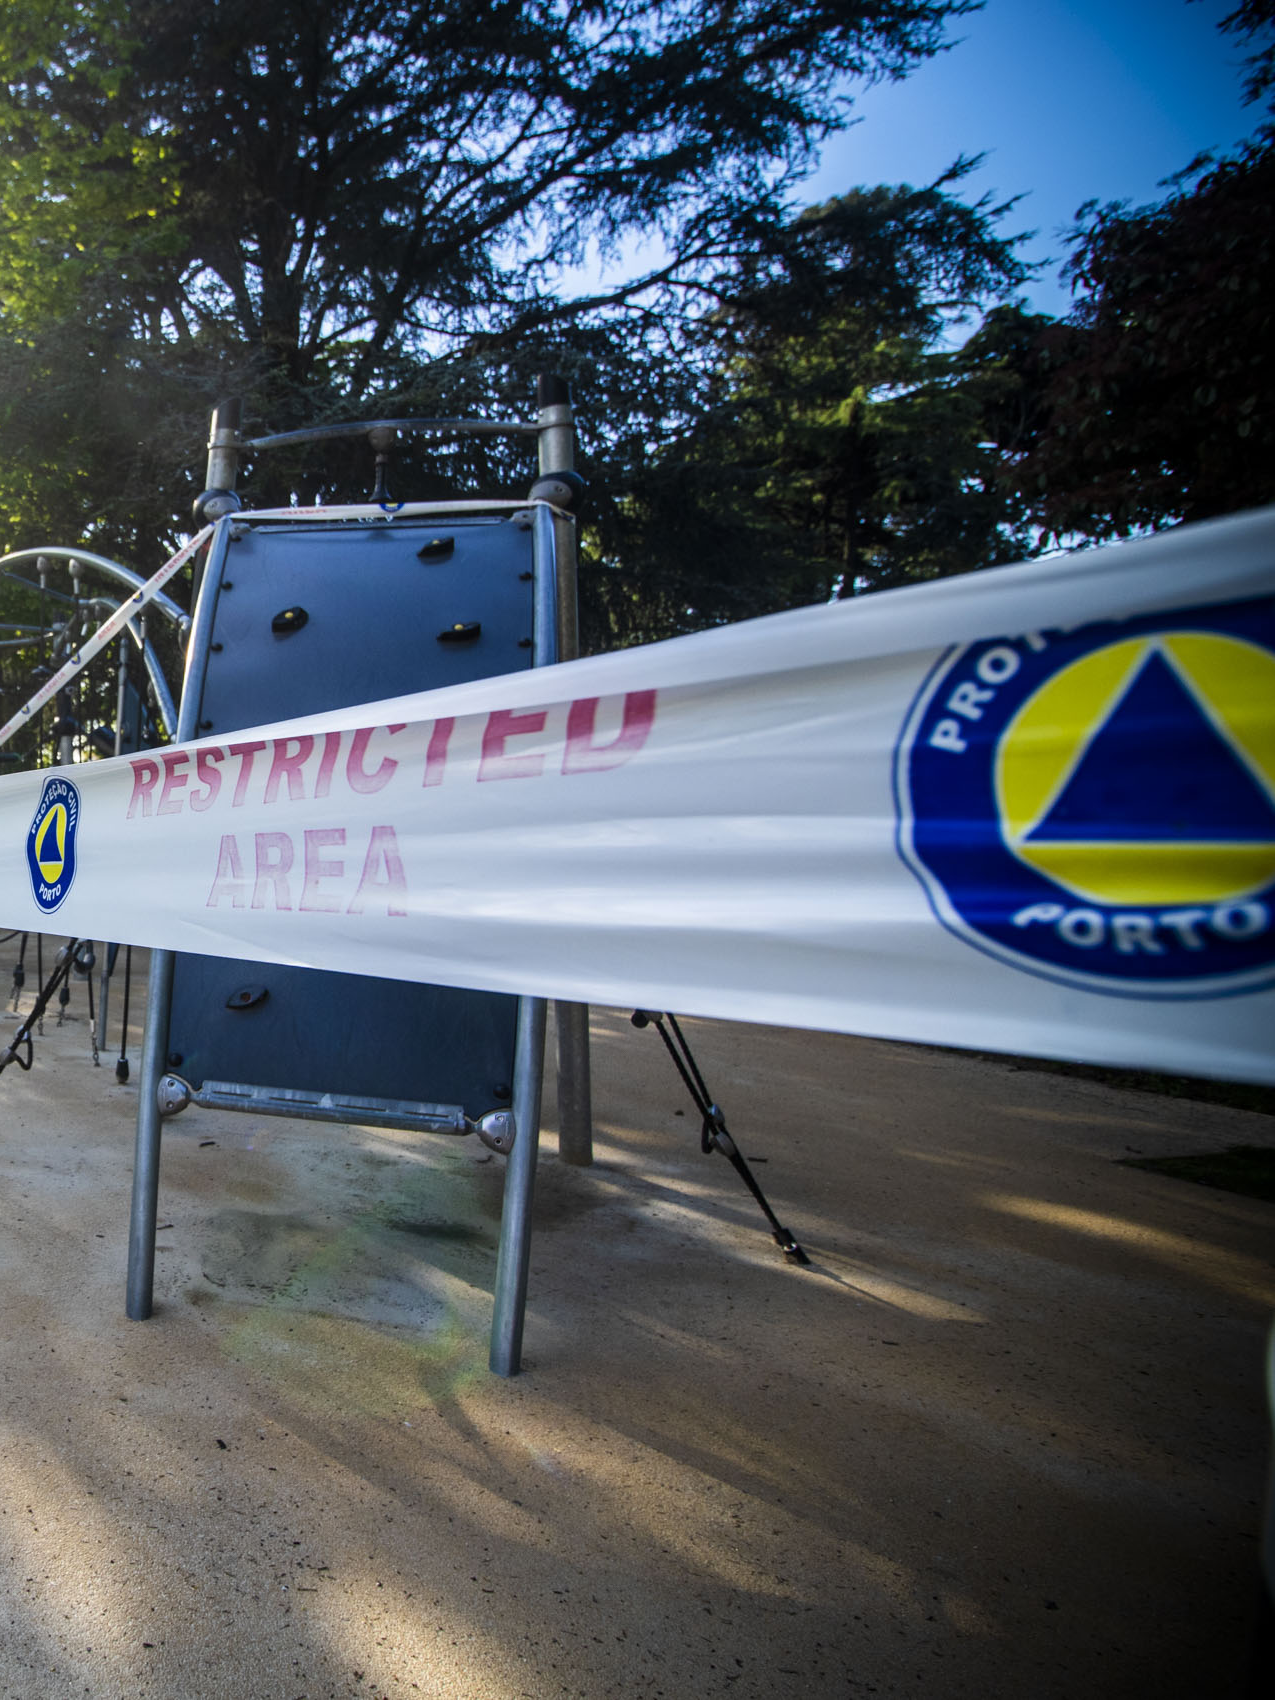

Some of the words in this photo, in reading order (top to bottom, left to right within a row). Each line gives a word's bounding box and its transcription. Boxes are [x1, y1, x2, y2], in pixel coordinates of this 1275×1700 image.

[126, 688, 658, 820] RESTRICTED
[31, 780, 67, 834] PROTEÇÃO
[67, 791, 78, 832] CIVIL
[39, 883, 62, 901] PORTO
[205, 825, 409, 917] AREA
[1012, 900, 1268, 954] PORTO
